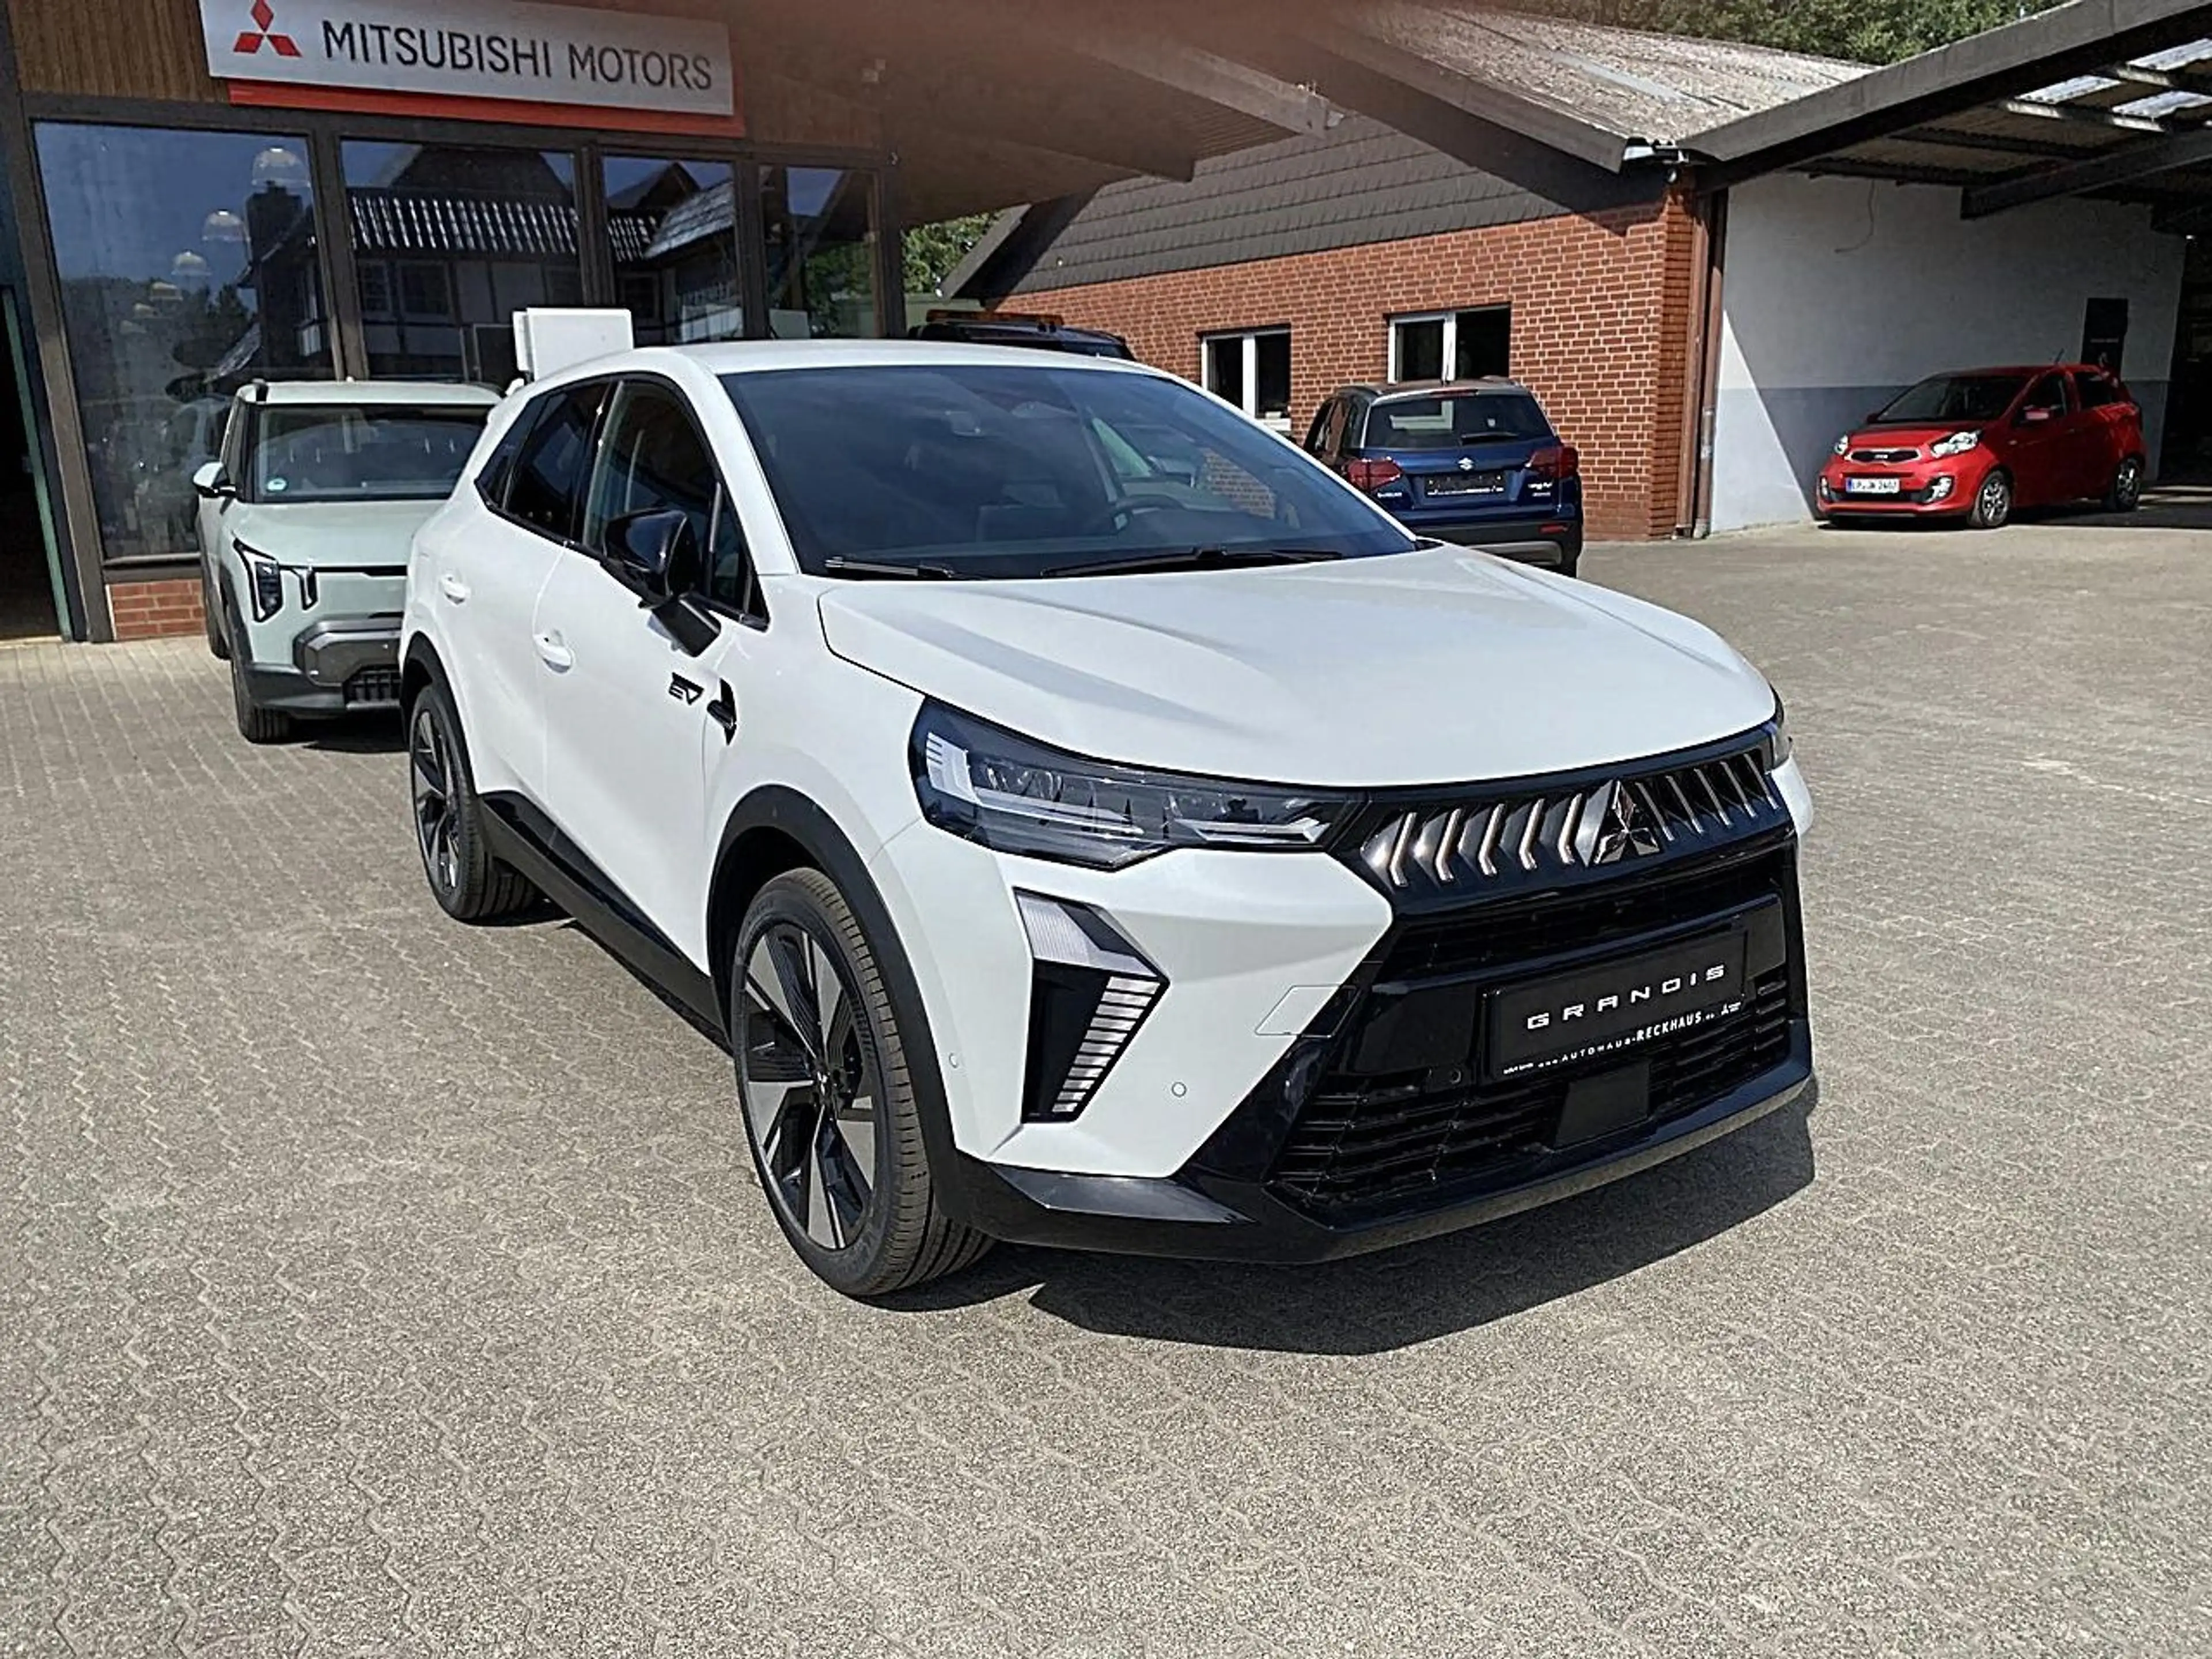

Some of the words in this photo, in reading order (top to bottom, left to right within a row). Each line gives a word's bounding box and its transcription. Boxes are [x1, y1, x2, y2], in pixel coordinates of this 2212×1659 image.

[322, 20, 552, 78] MITSUBISHI
[569, 42, 712, 90] MOTORS
[1527, 964, 1725, 1030] GRANDIS
